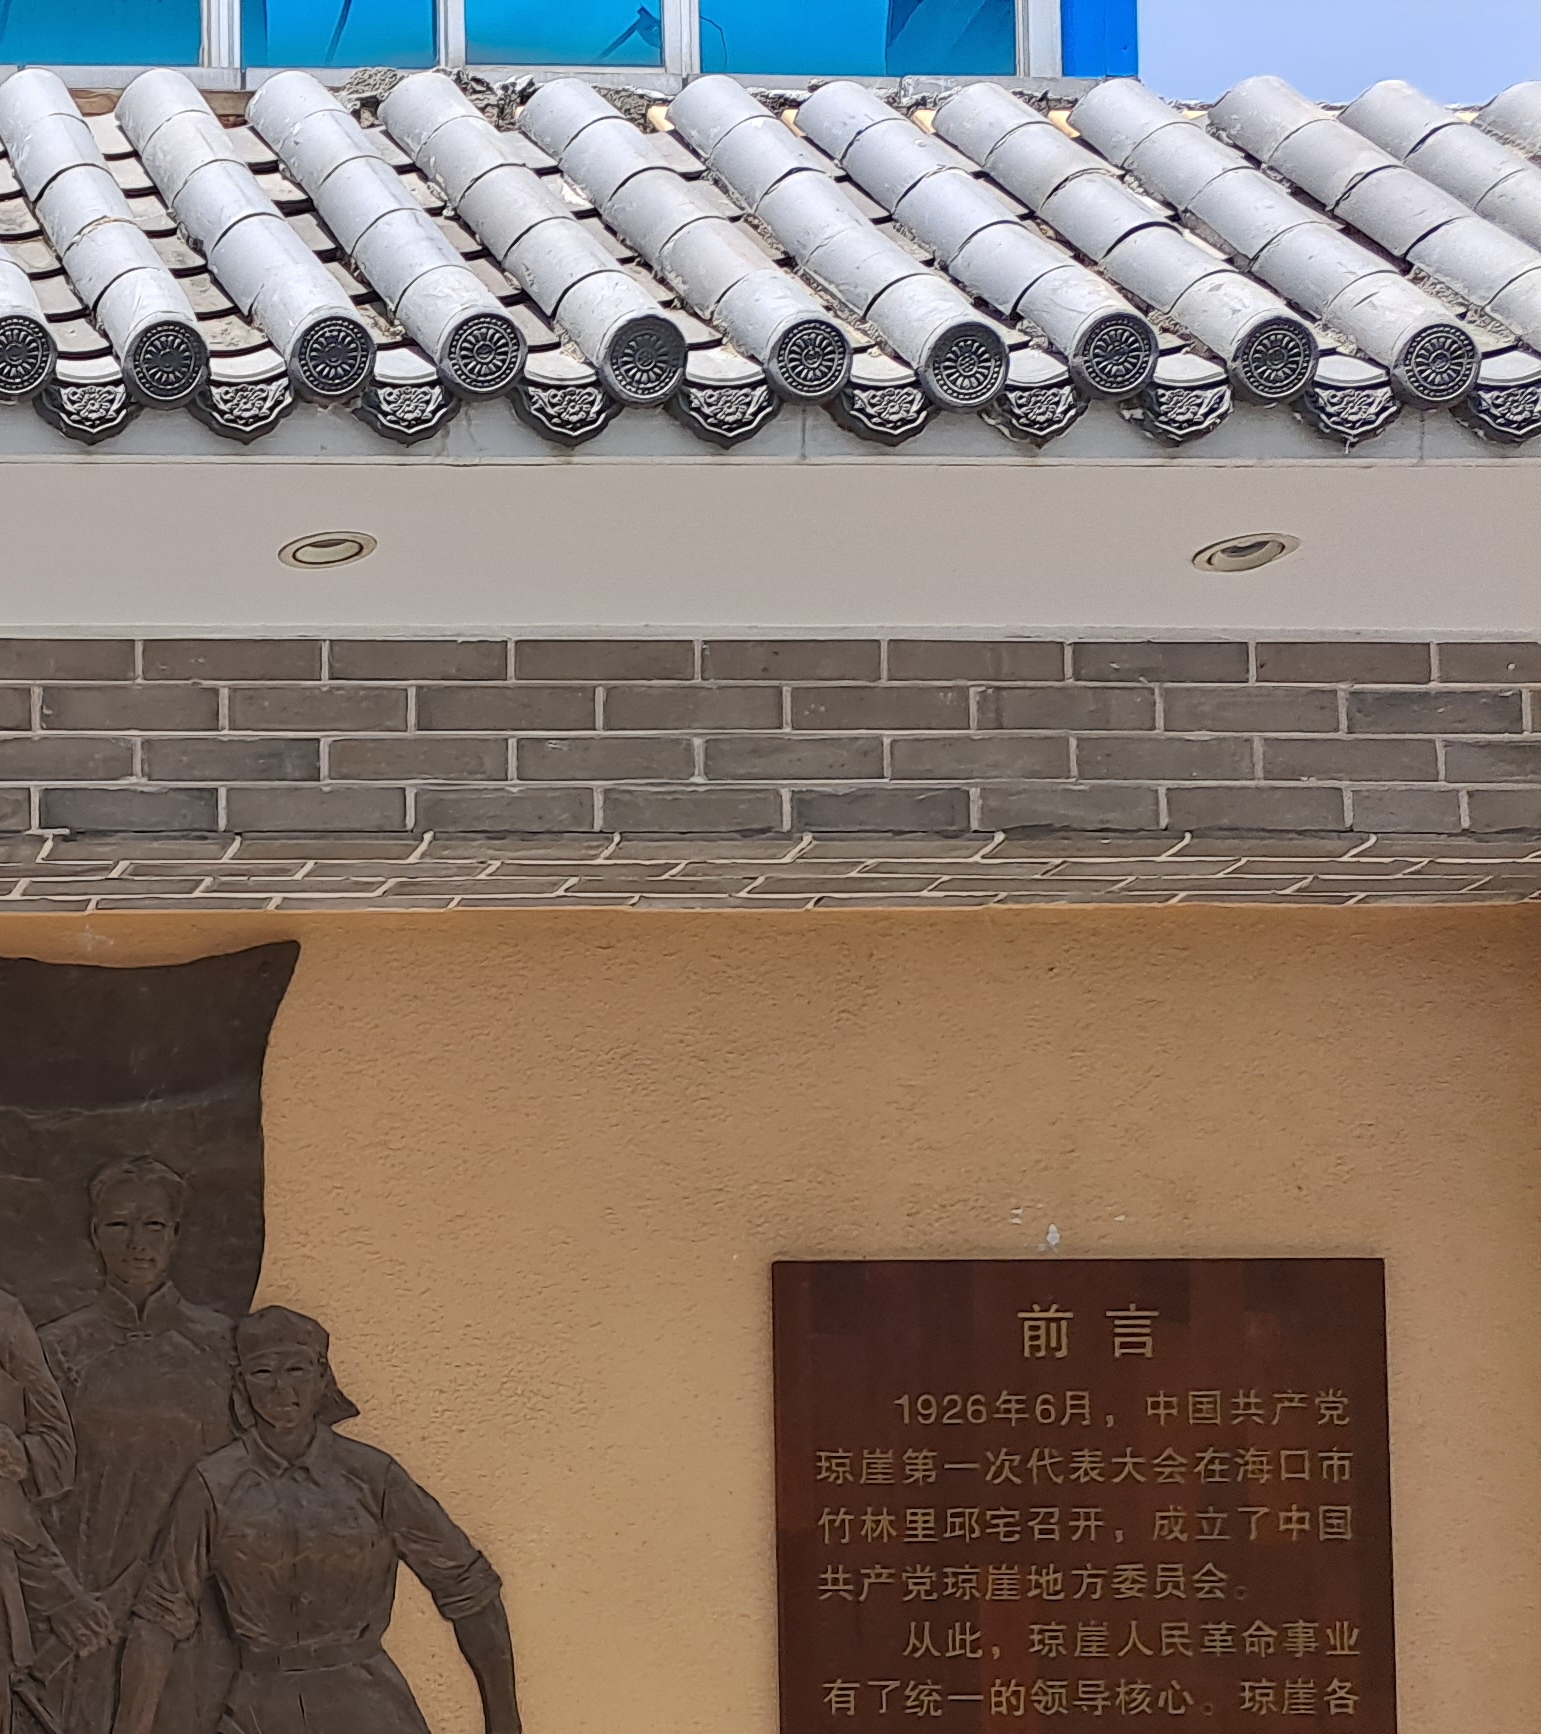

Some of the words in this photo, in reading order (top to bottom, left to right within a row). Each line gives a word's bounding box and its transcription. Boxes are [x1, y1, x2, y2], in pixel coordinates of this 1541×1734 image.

[1017, 1303, 1159, 1359] 前言
[894, 1389, 1351, 1427] 1926年6月，中国共产党
[816, 1447, 1354, 1485] 琼崖第一次代表大会在海口市
[817, 1505, 1354, 1544] 竹林里邱宅召开，成立了中国
[818, 1561, 1249, 1601] 共产党琼崖地方委员会。
[901, 1619, 1361, 1660] 从此，琼崖人民革命事业
[821, 1678, 1361, 1718] 有了统一的领导核心。琼崖各
